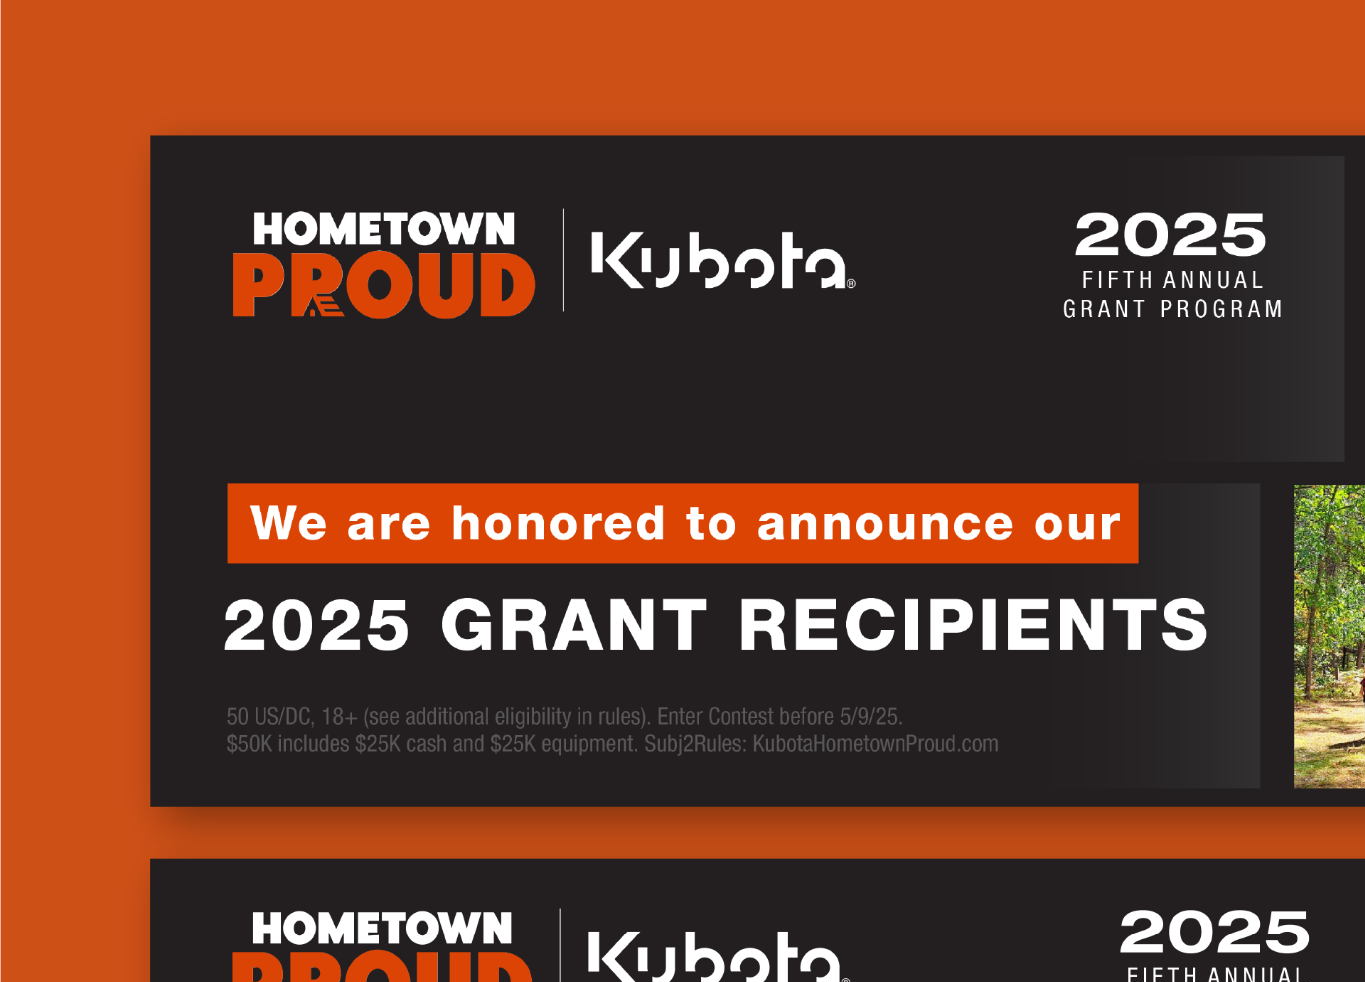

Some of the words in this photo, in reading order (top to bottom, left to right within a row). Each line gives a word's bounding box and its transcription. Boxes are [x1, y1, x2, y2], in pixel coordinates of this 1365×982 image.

[253, 210, 515, 246] HOMETOWN
[1074, 212, 1266, 257] 2025
[232, 250, 536, 320] PROUD
[1082, 270, 1152, 289] FIFTH
[1162, 270, 1264, 290] ANNUAL
[1063, 298, 1145, 319] GRANT
[1161, 298, 1282, 319] PROGRAM
[249, 504, 327, 541] We
[347, 512, 430, 541] are
[453, 504, 664, 541] honored
[685, 506, 736, 541] to
[757, 512, 1013, 541] announce
[1035, 512, 1121, 541] our
[224, 598, 409, 652] 2025
[441, 597, 707, 652] GRANT
[741, 597, 1207, 652] RECIPIENTS
[226, 706, 249, 726] 50
[255, 706, 315, 728] US/DC,
[322, 706, 358, 726] 18+
[363, 707, 400, 729] (see
[405, 706, 489, 726] additional
[494, 706, 572, 730] eligibility
[577, 706, 592, 726] in
[598, 706, 651, 730] rules).
[658, 706, 704, 726] Enter
[708, 706, 775, 726] Contest
[779, 706, 834, 726] before
[840, 706, 903, 726] 5/9/25.
[226, 733, 273, 755] $50K
[278, 734, 350, 753] includes
[355, 733, 401, 755] $25K
[406, 734, 447, 753] cash
[453, 734, 485, 753] and
[490, 733, 537, 755] $25K
[541, 734, 638, 756] equipment.
[644, 733, 747, 757] Subj2Rules:
[753, 734, 999, 753] KubotaHometownProud.com
[252, 910, 512, 946] HOMETOWN
[1119, 909, 1310, 954] 2025
